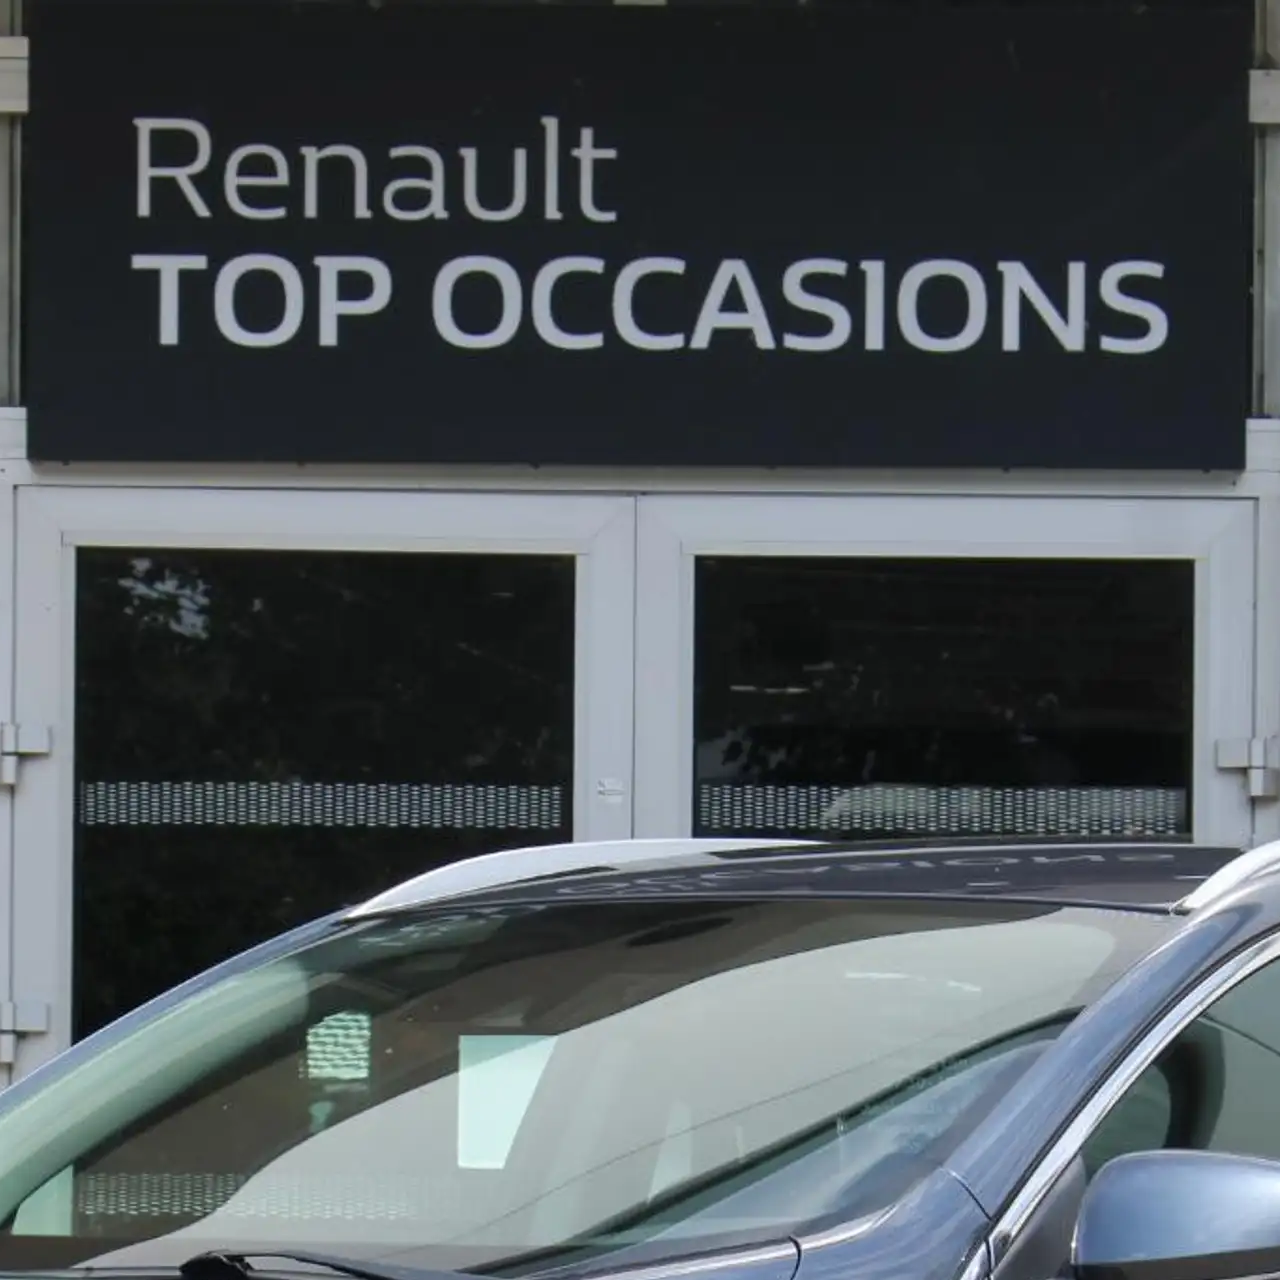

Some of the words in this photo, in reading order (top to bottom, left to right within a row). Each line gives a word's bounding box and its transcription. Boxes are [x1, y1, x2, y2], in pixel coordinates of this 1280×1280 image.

[134, 117, 616, 221] Renault
[132, 254, 391, 347] TOP
[433, 256, 1168, 353] OCCASIONS
